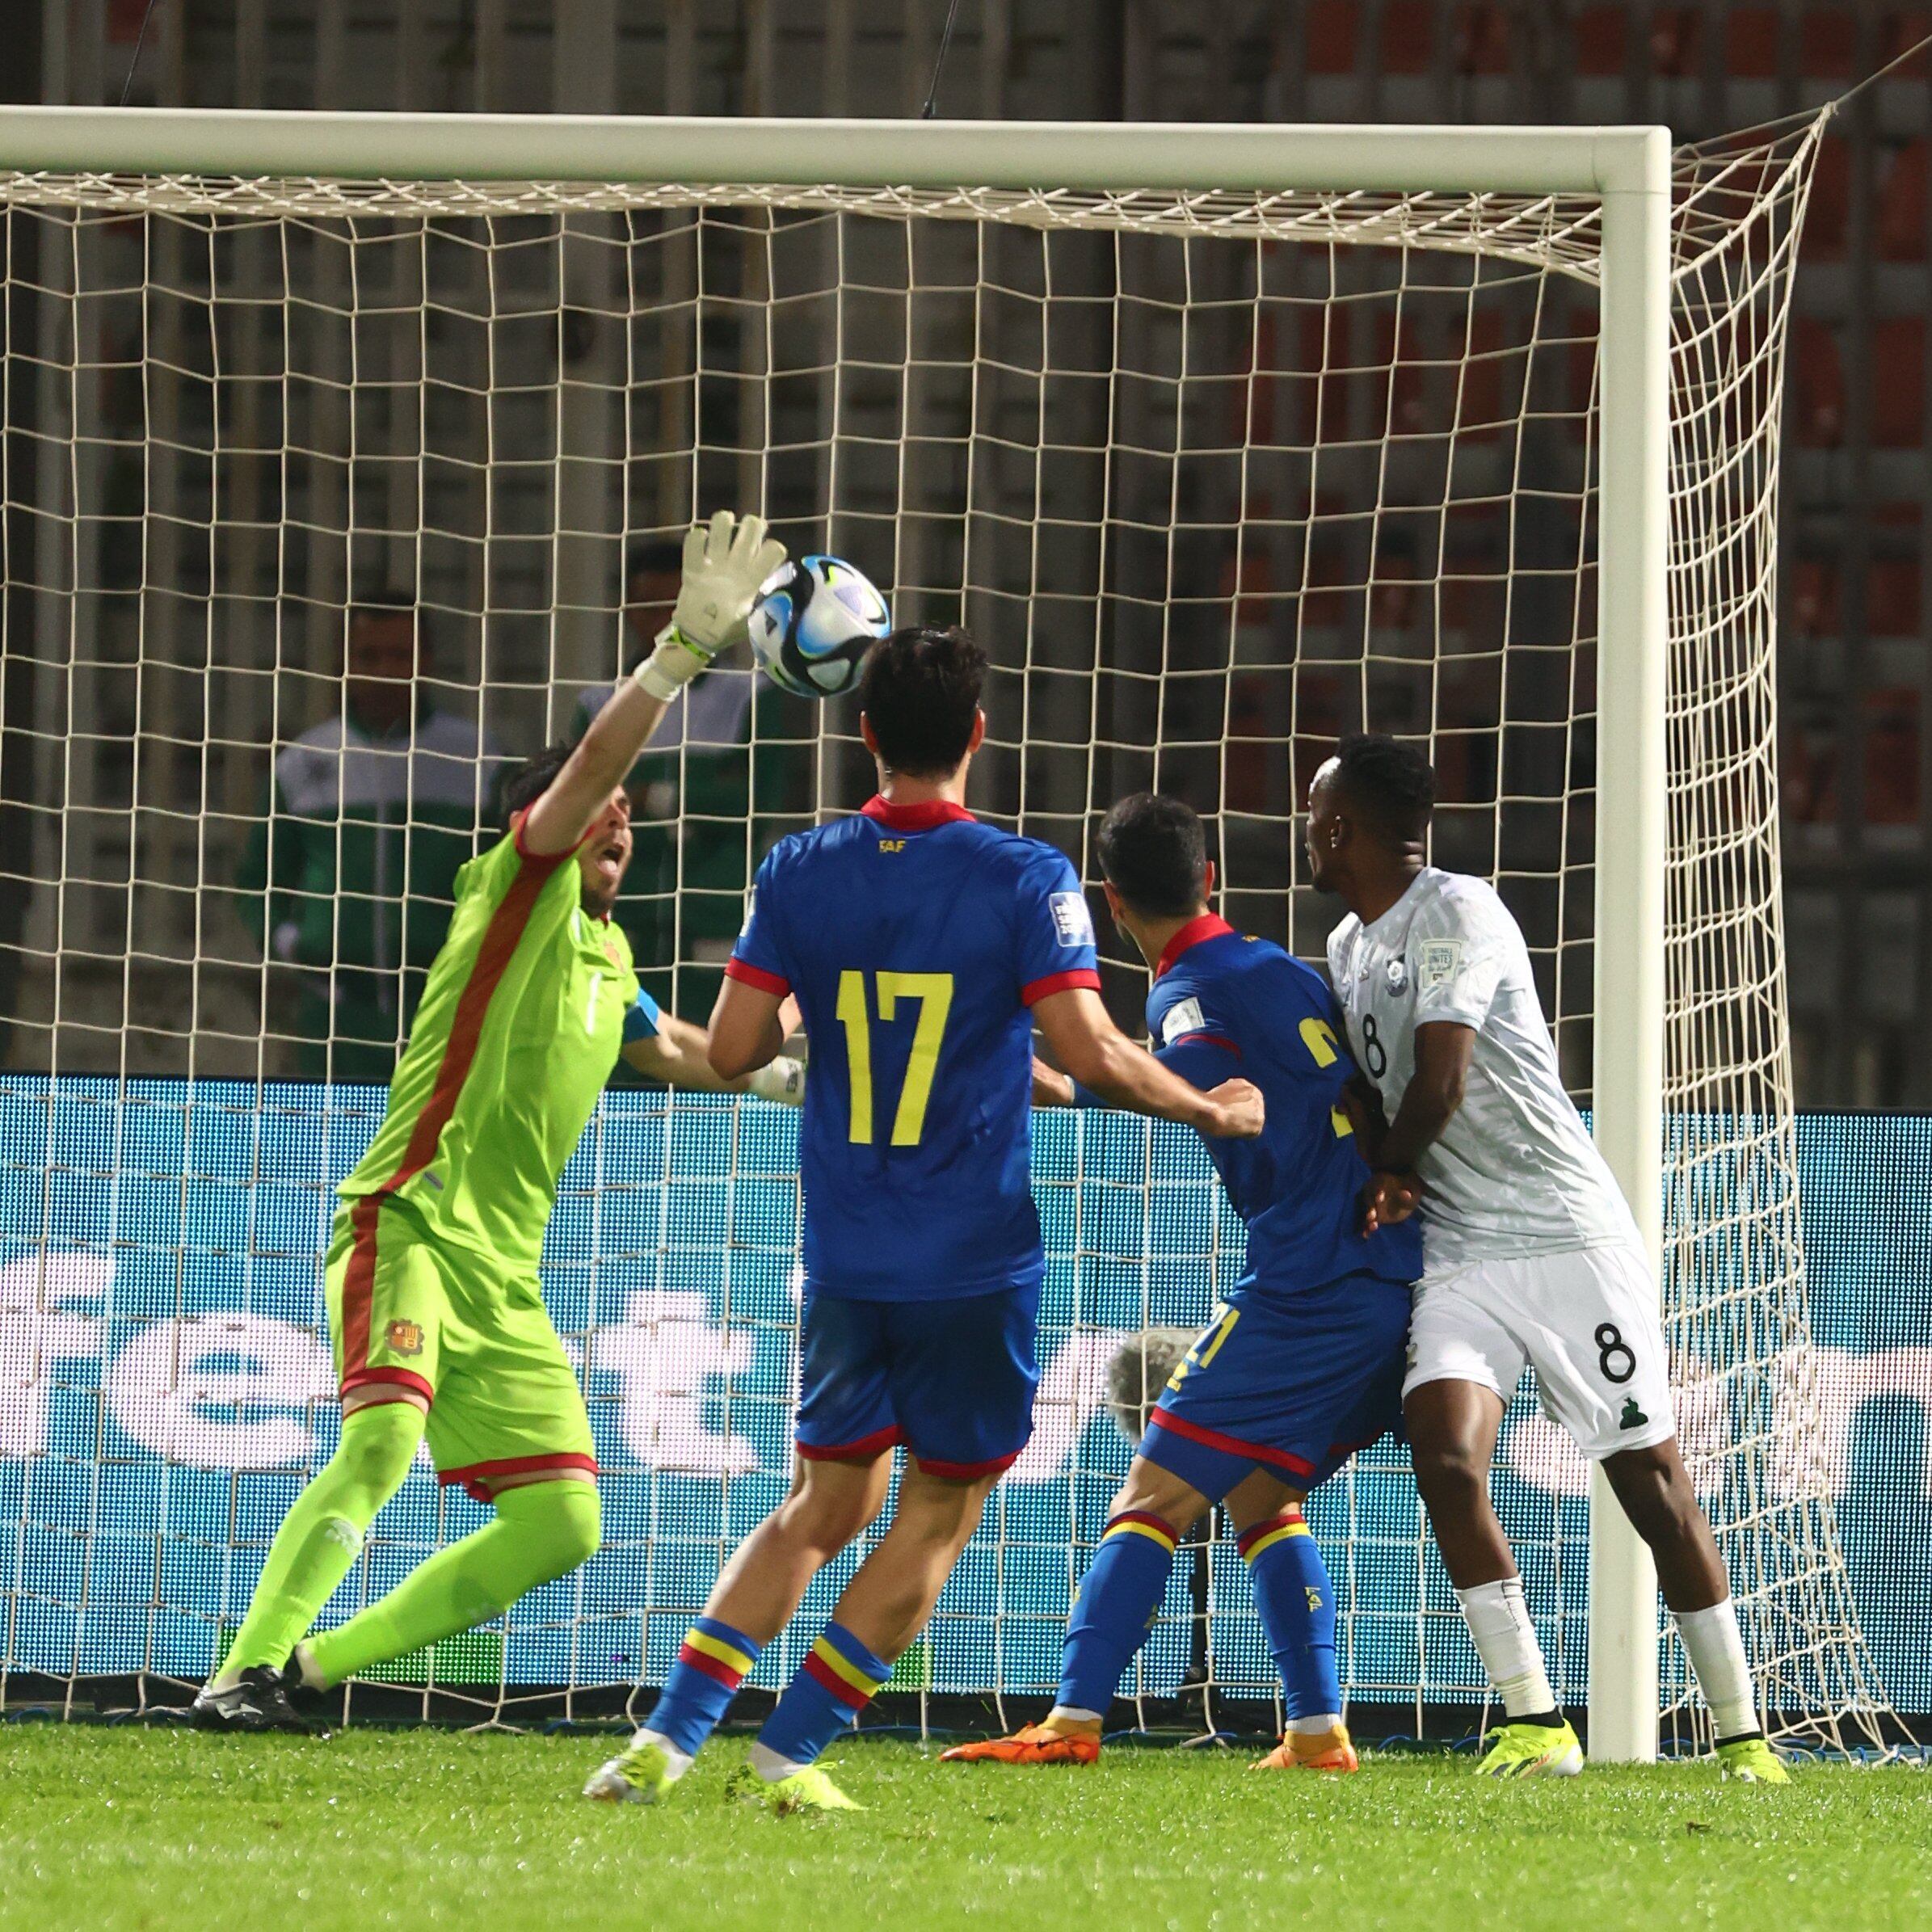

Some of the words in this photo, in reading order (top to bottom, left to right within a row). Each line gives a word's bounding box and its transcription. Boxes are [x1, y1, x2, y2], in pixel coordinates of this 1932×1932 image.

[836, 970, 954, 1147] 17
[1362, 1012, 1387, 1080] 8
[1593, 1321, 1637, 1384] 8
